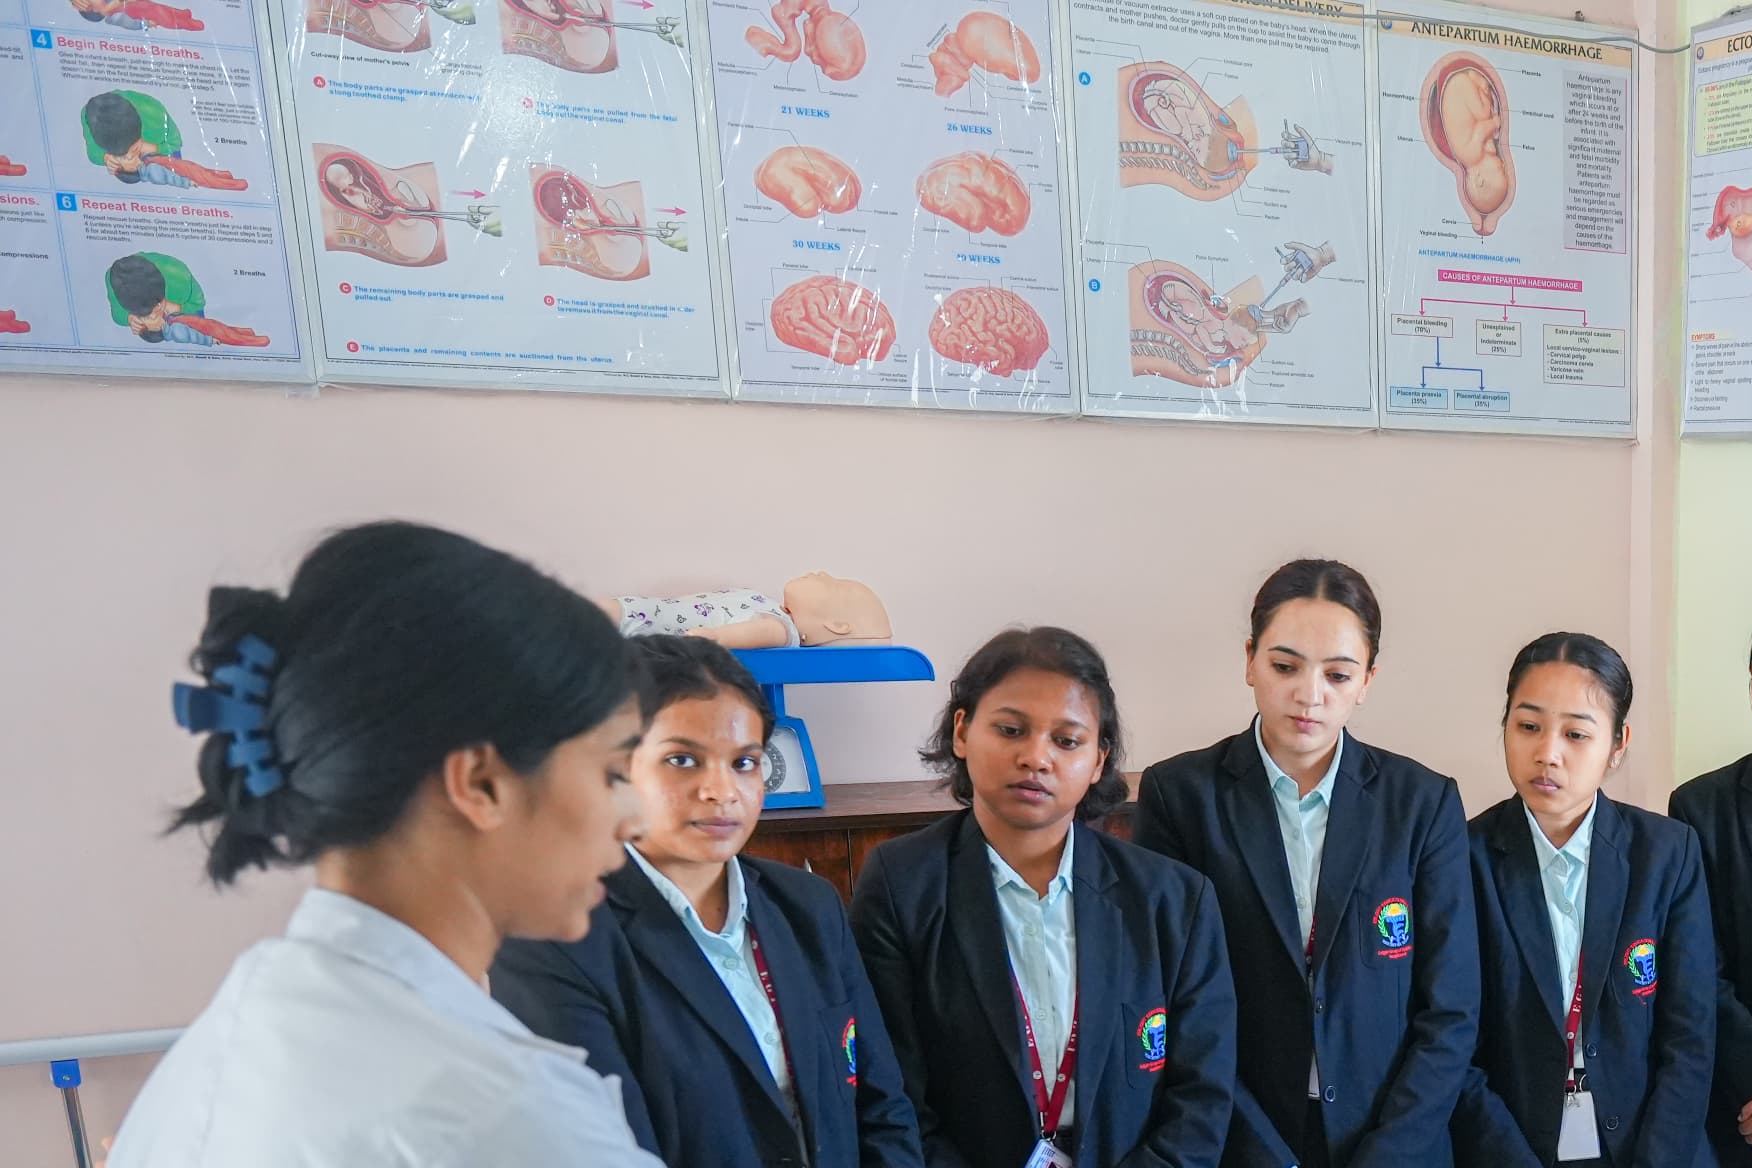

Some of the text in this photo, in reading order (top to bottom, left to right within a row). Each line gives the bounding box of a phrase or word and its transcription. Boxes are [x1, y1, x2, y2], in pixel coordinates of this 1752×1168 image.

[1124, 0, 1149, 10] vacuum
[1151, 4, 1178, 14] extractor
[1180, 8, 1195, 16] uses
[1216, 14, 1227, 22] cup
[1228, 16, 1248, 24] placed
[1270, 21, 1290, 30] baby's
[37, 32, 47, 45] 4
[1412, 22, 1604, 60] ANTEPARTUM HAEMORRHAGE
[57, 36, 204, 60] Begin Rescue Breaths.
[781, 105, 830, 118] 21 WEEKS
[947, 123, 992, 135] 26 WEEKS
[220, 138, 247, 146] Breaths
[62, 196, 71, 209] 6
[81, 199, 233, 218] Repeat Rescue Breaths.
[793, 240, 840, 251] 30 WEEKS
[970, 255, 1000, 265] WEEKS
[240, 270, 266, 278] Breaths
[1442, 272, 1578, 290] CAUSES OF ANTEPARTUM HAEMORRHAGE
[1396, 317, 1448, 328] Placental bleeding
[1482, 324, 1514, 332] Unexplained
[361, 344, 375, 352] The
[431, 348, 466, 357] remaining
